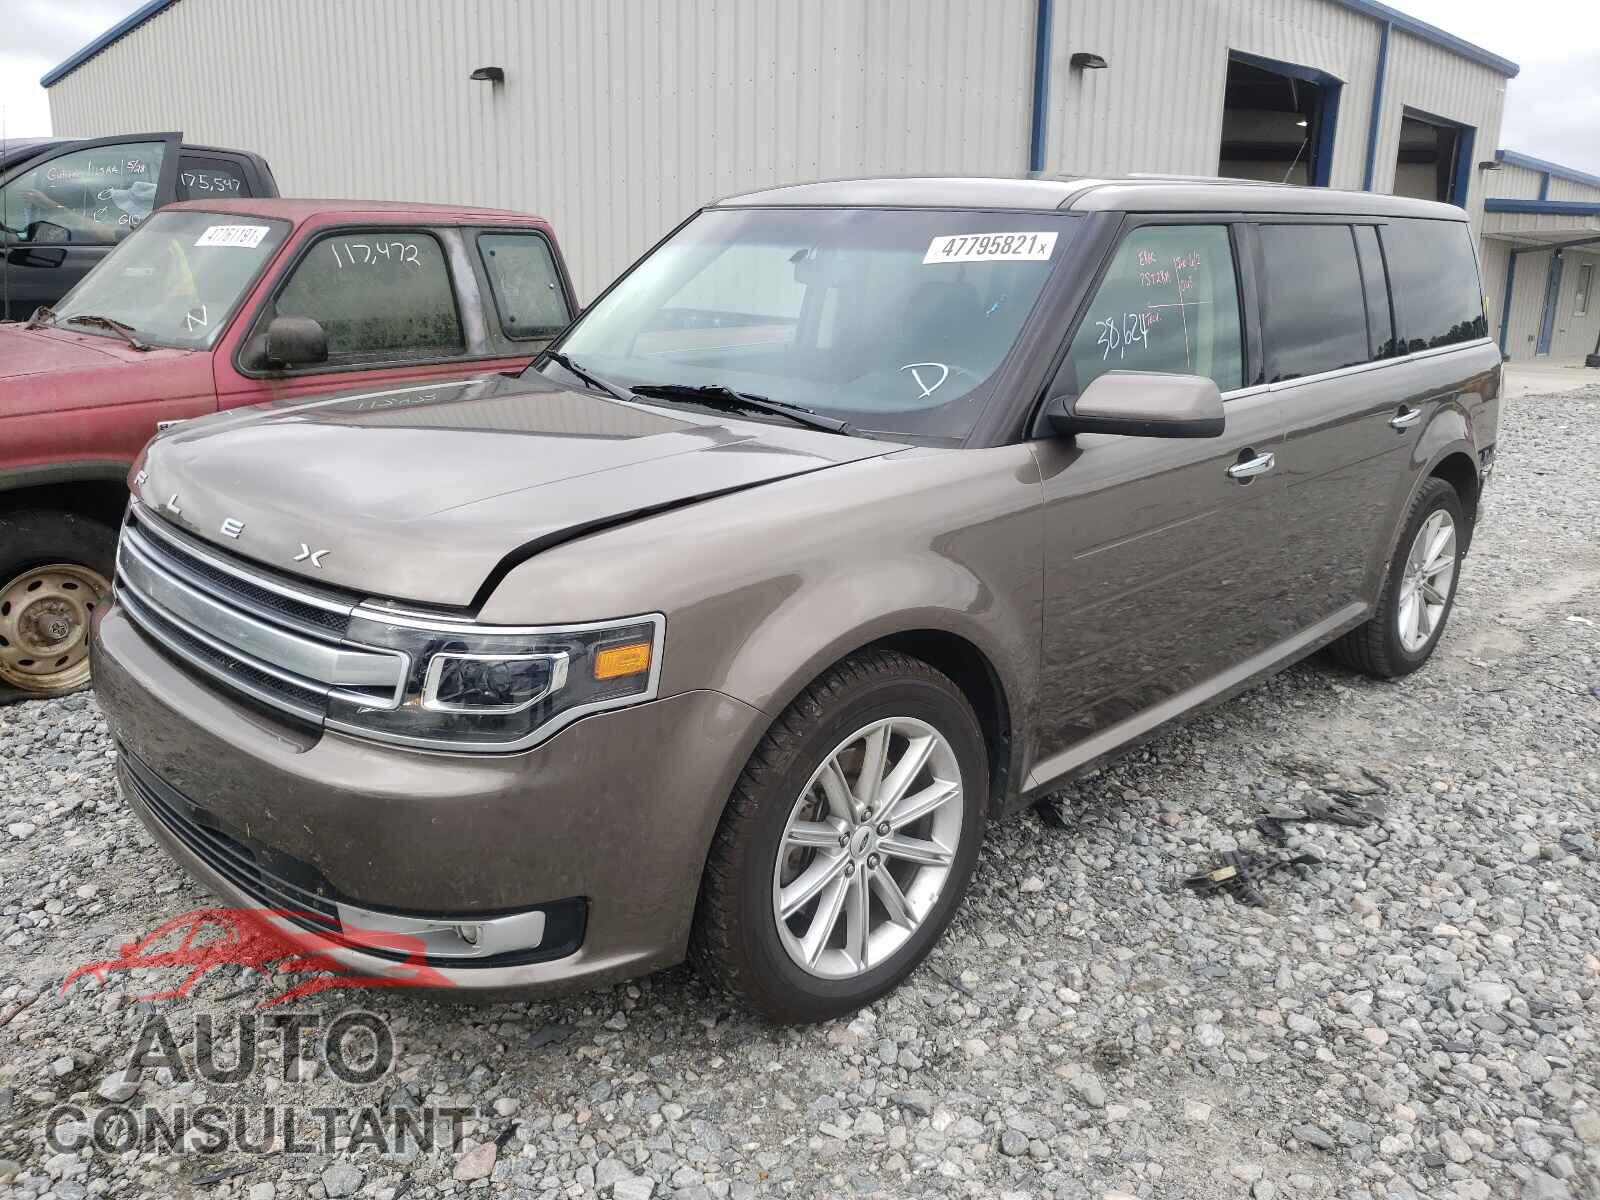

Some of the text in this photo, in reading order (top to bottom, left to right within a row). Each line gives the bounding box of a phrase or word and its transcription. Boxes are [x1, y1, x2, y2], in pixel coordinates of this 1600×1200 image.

[179, 171, 241, 193] 175,547
[331, 241, 421, 268] 117,472
[185, 304, 208, 332] N
[1096, 312, 1150, 361] 38,624
[900, 362, 949, 400] D
